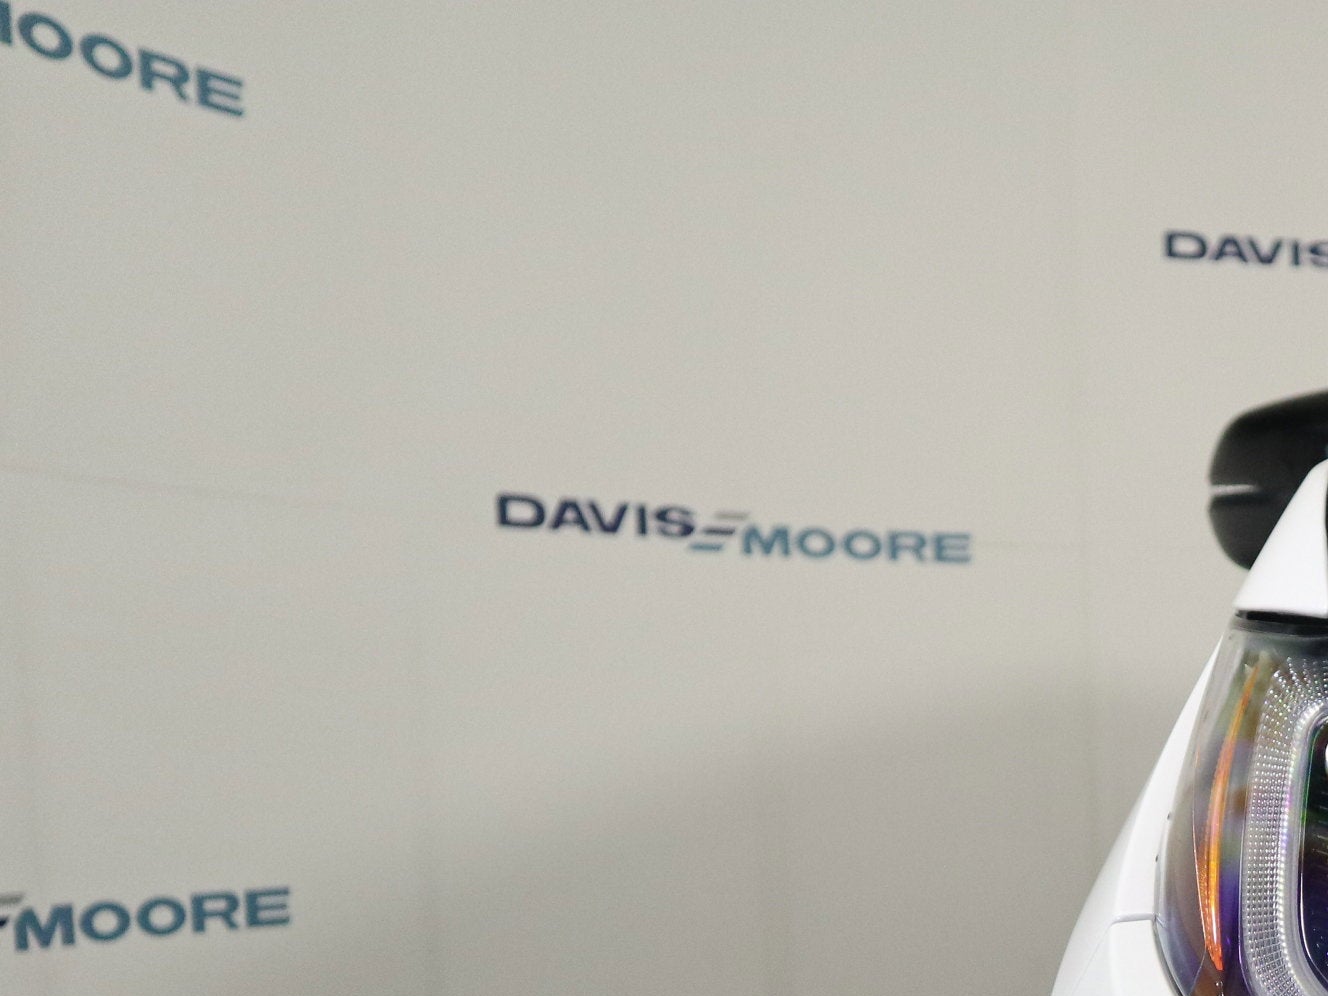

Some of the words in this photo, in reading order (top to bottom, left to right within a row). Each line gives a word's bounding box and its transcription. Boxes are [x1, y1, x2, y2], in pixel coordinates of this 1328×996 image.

[0, 1, 244, 117] OORE
[495, 492, 695, 538] DAVIS
[741, 523, 972, 564] MOORE
[13, 886, 290, 951] MOORE
